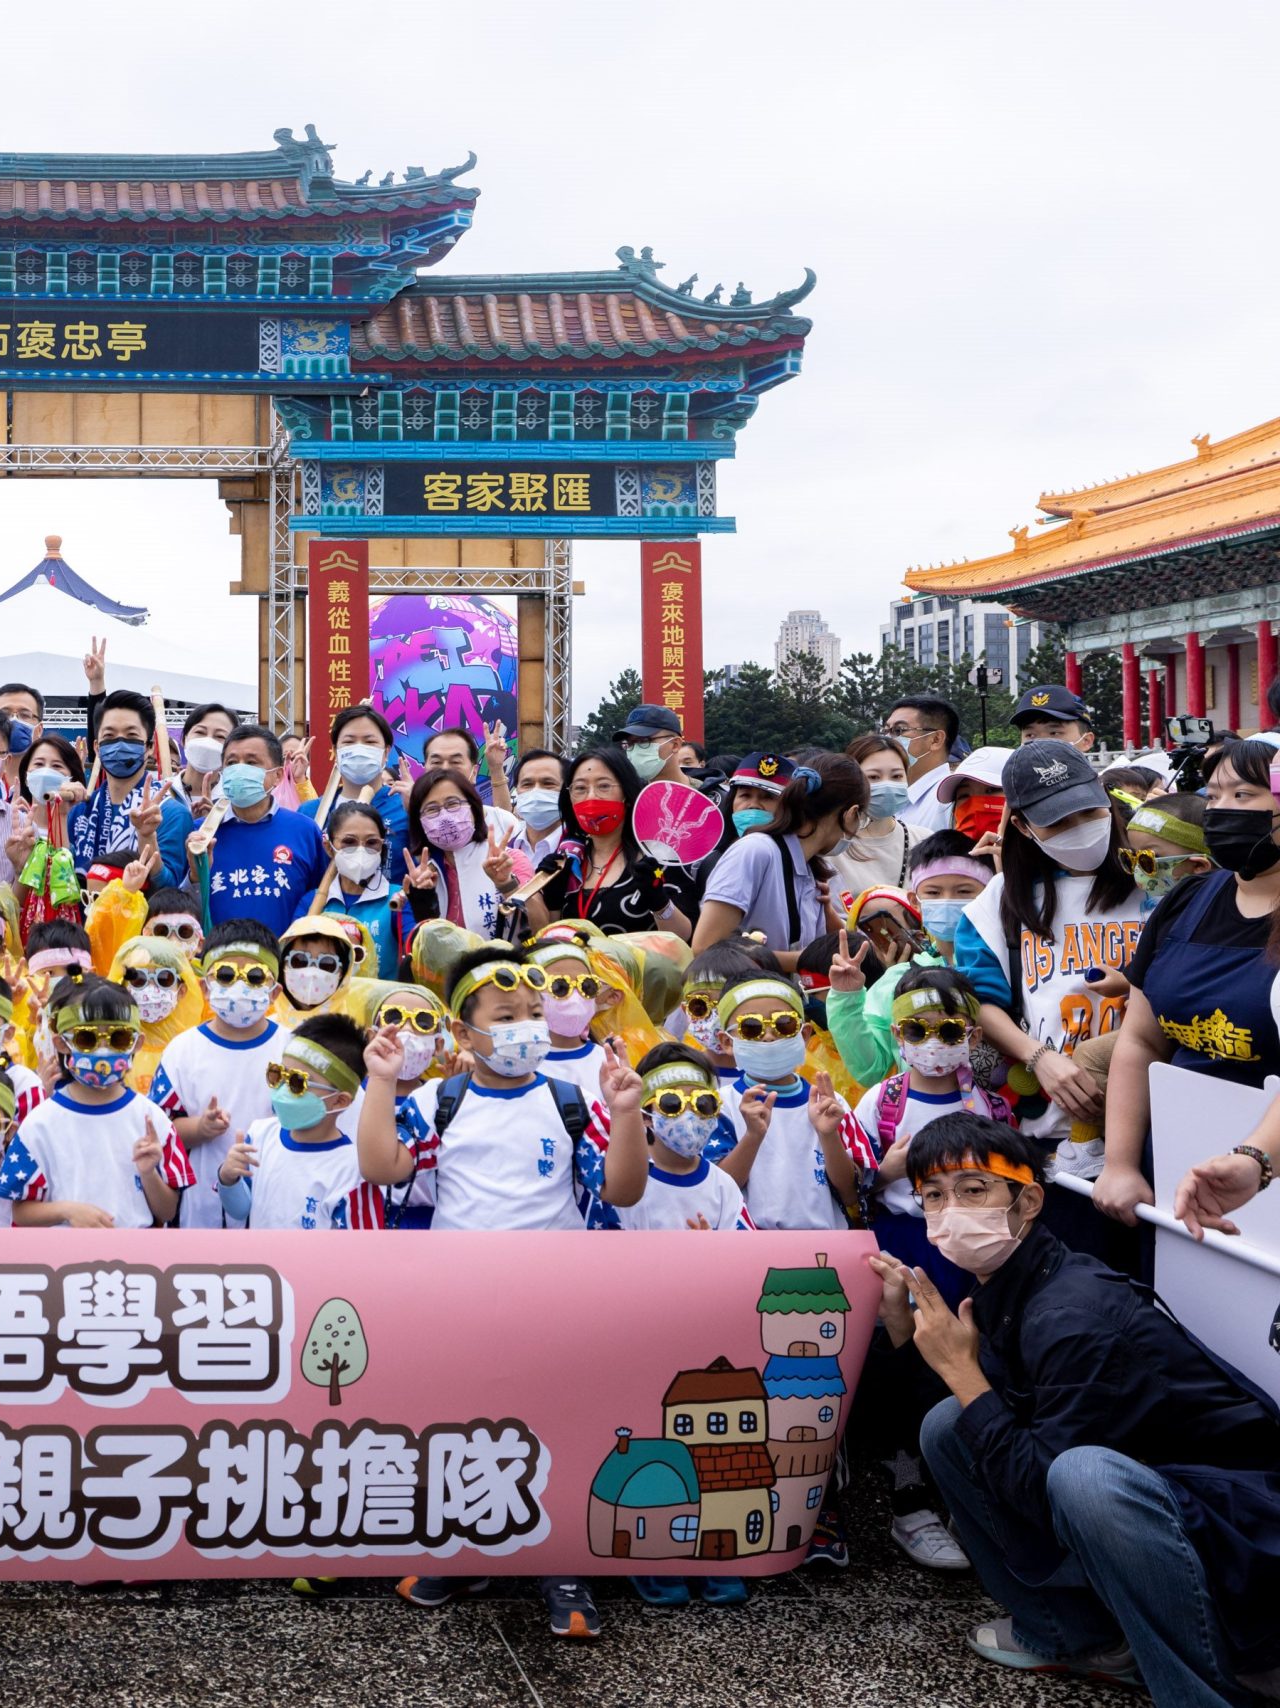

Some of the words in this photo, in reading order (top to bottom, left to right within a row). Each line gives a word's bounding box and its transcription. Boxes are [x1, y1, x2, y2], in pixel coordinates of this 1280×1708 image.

[423, 471, 591, 512] 客家聚匯
[327, 580, 352, 762] 義從血性流
[661, 581, 686, 742] 褒來地闕天章
[1045, 772, 1071, 787] CELINE
[1060, 918, 1147, 975] ANGE
